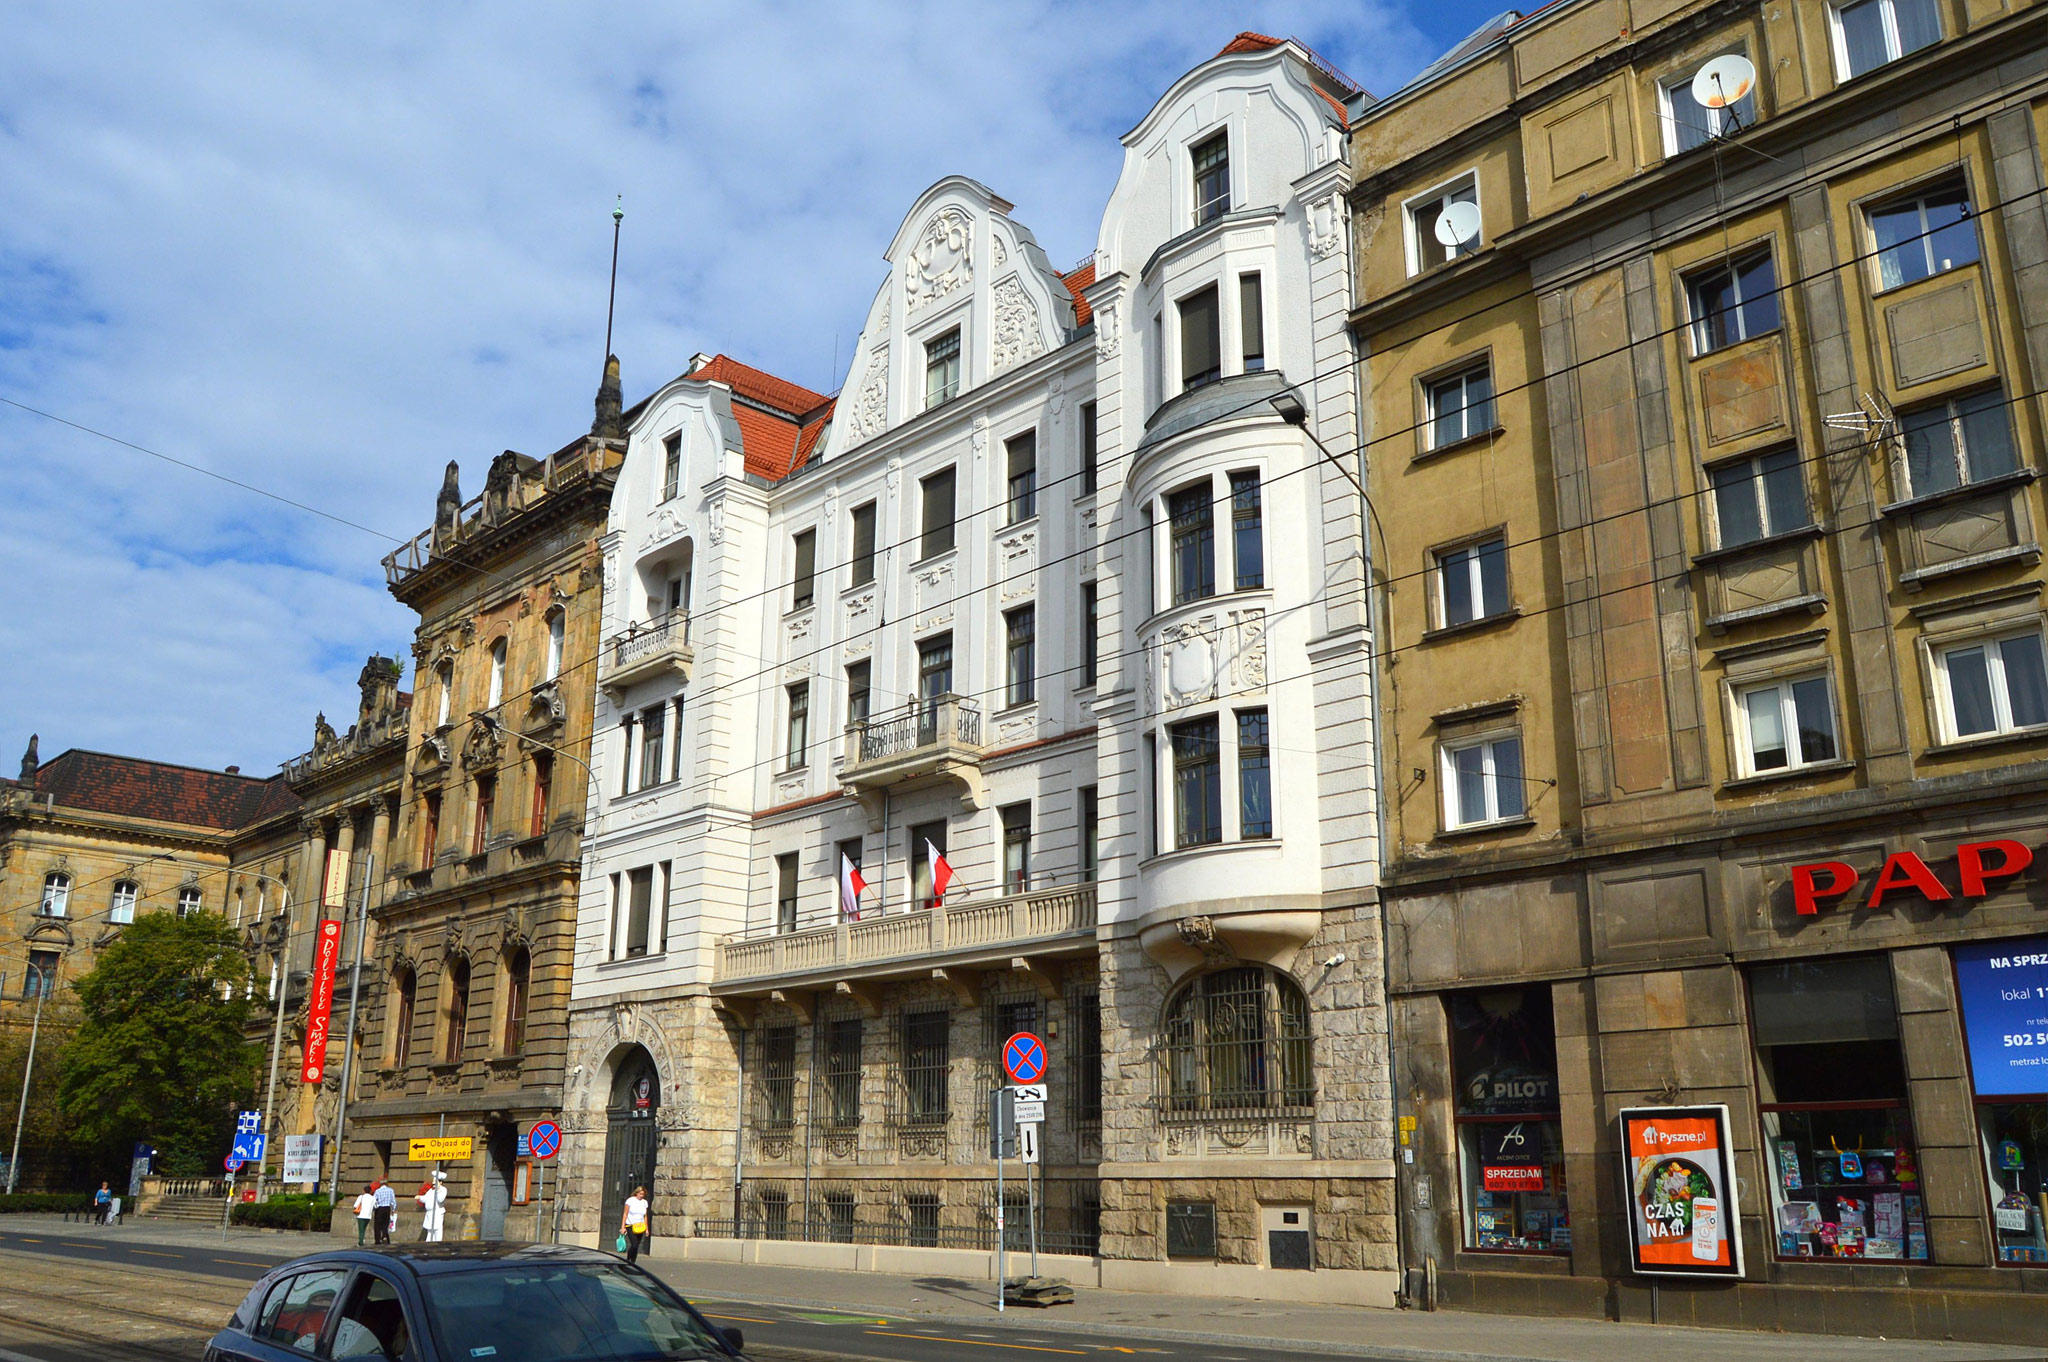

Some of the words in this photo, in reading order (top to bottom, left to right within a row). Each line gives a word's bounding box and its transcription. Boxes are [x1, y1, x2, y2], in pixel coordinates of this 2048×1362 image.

[1791, 839, 2034, 915] PAP
[1990, 957, 2011, 969] NA
[2013, 953, 2048, 967] SPRZ
[317, 938, 334, 1010] Polskie
[2001, 987, 2031, 1001] lokal
[309, 1016, 326, 1063] Smaki
[2003, 1033, 2034, 1047] 502
[2036, 1032, 2048, 1045] 5
[2010, 1056, 2040, 1066] metraż
[1494, 1081, 1549, 1098] PILOT
[430, 1139, 458, 1148] Objazd
[1659, 1131, 1707, 1145] Pyszne.pl
[1486, 1169, 1542, 1179] SPRZEDAM
[1645, 1201, 1685, 1220] CZAS
[1646, 1222, 1669, 1238] NA
